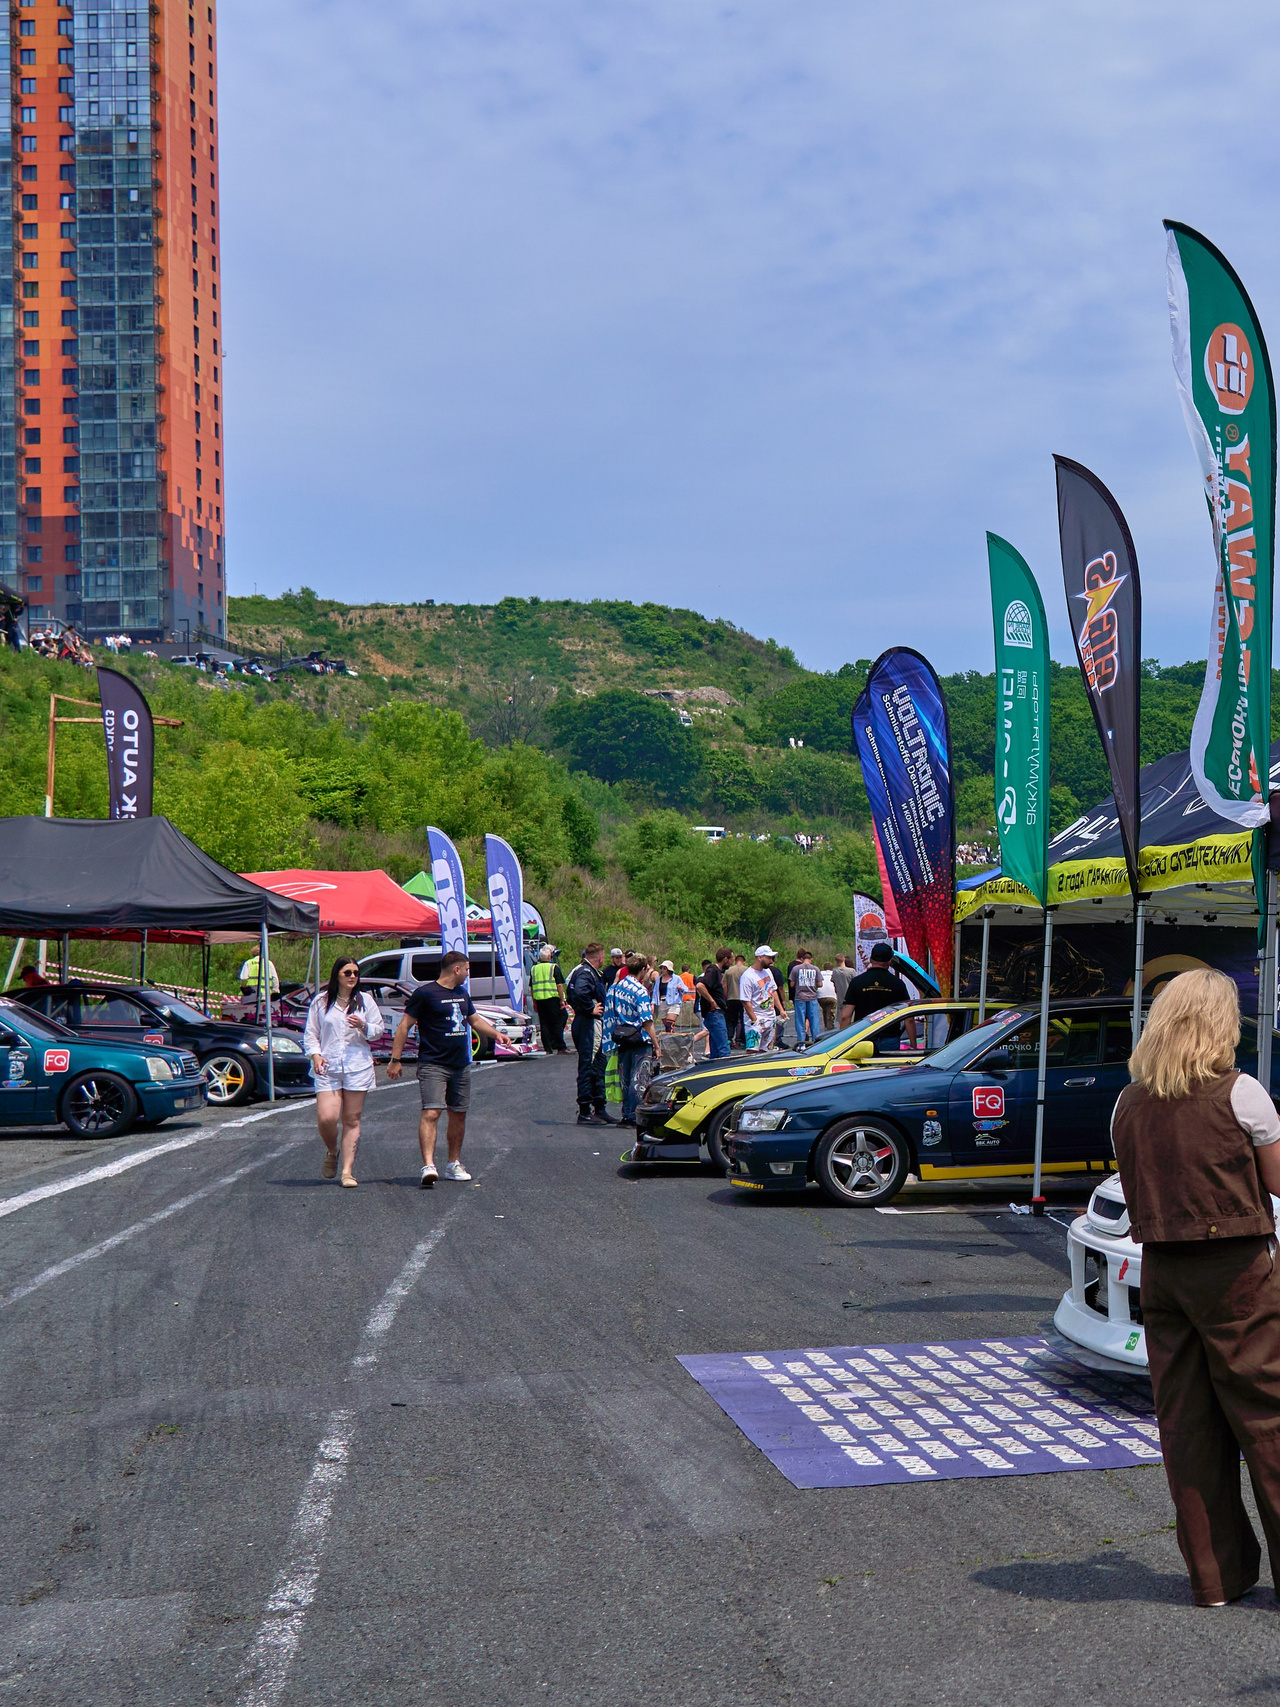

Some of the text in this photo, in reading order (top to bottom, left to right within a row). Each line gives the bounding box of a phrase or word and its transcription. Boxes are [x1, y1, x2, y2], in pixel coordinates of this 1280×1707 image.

[881, 693, 911, 765] Schmierstoffe
[906, 765, 929, 829] Deutschland
[891, 684, 946, 823] VOLTRONIC
[903, 808, 919, 849] КОНТРОЛЬ
[915, 847, 929, 886] КАЧЕСТВА
[908, 797, 935, 884] НЕМЕЦКИЕ ТЕХНОЛОГИИ
[1057, 874, 1064, 892] 2
[1064, 870, 1085, 893] ГОДА
[1145, 857, 1167, 877] ВСЮ
[1170, 841, 1252, 872] СПЕЦТЕХНИКУ
[46, 1054, 67, 1067] FQ
[975, 1094, 1001, 1111] FQ
[1127, 1336, 1137, 1346] FQ
